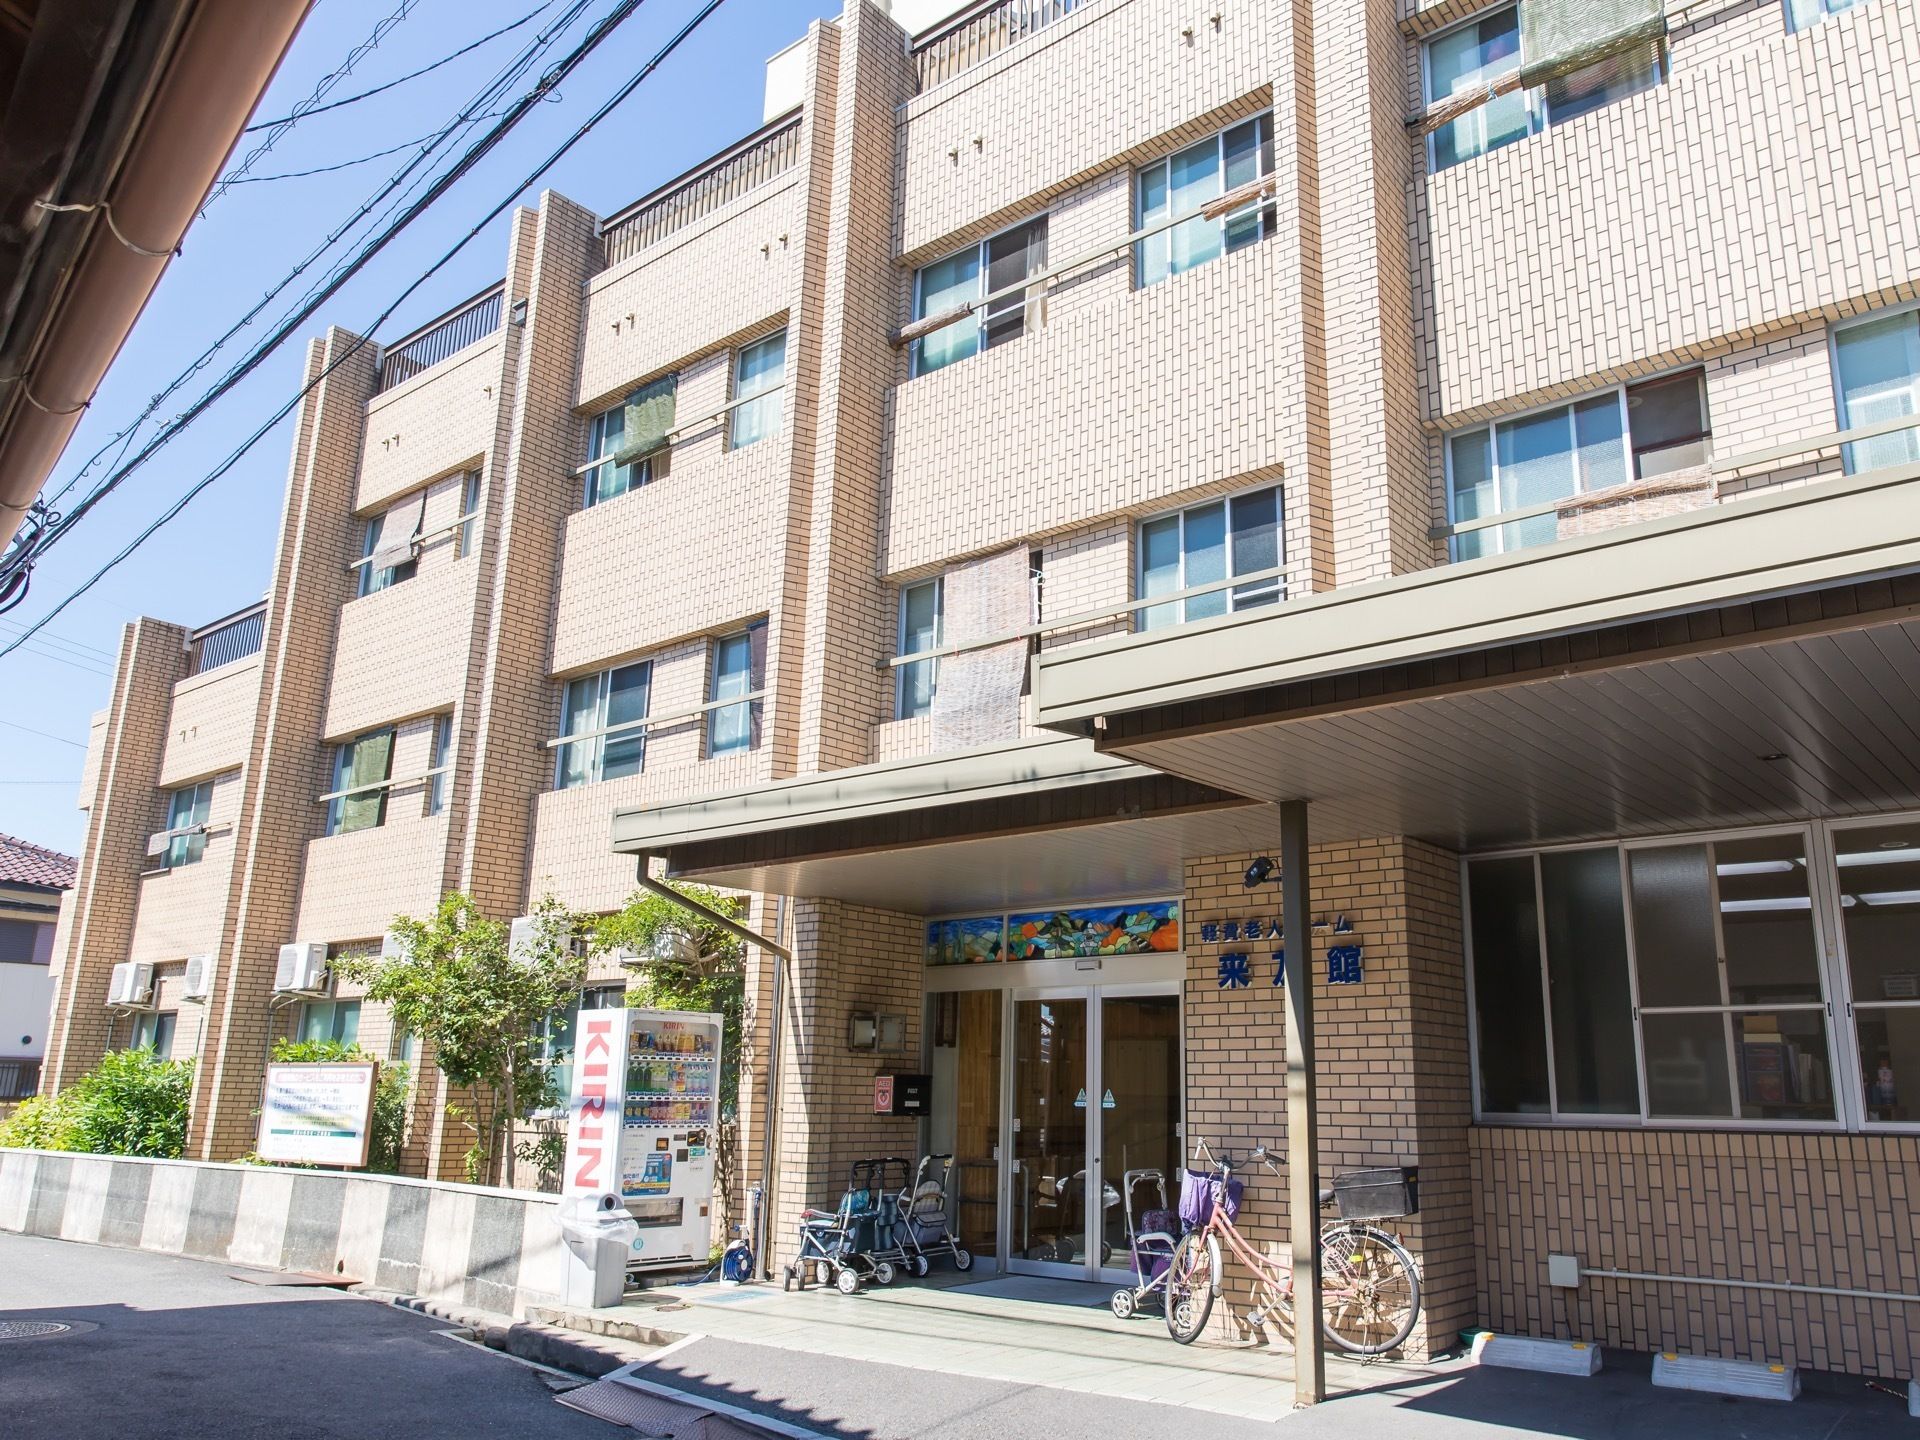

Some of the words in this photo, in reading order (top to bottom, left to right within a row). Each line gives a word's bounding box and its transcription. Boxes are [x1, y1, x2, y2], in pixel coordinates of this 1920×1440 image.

[1201, 914, 1354, 943] 軽費老人ーム
[663, 1022, 685, 1030] KIRIN
[575, 1020, 612, 1188] KIRIN
